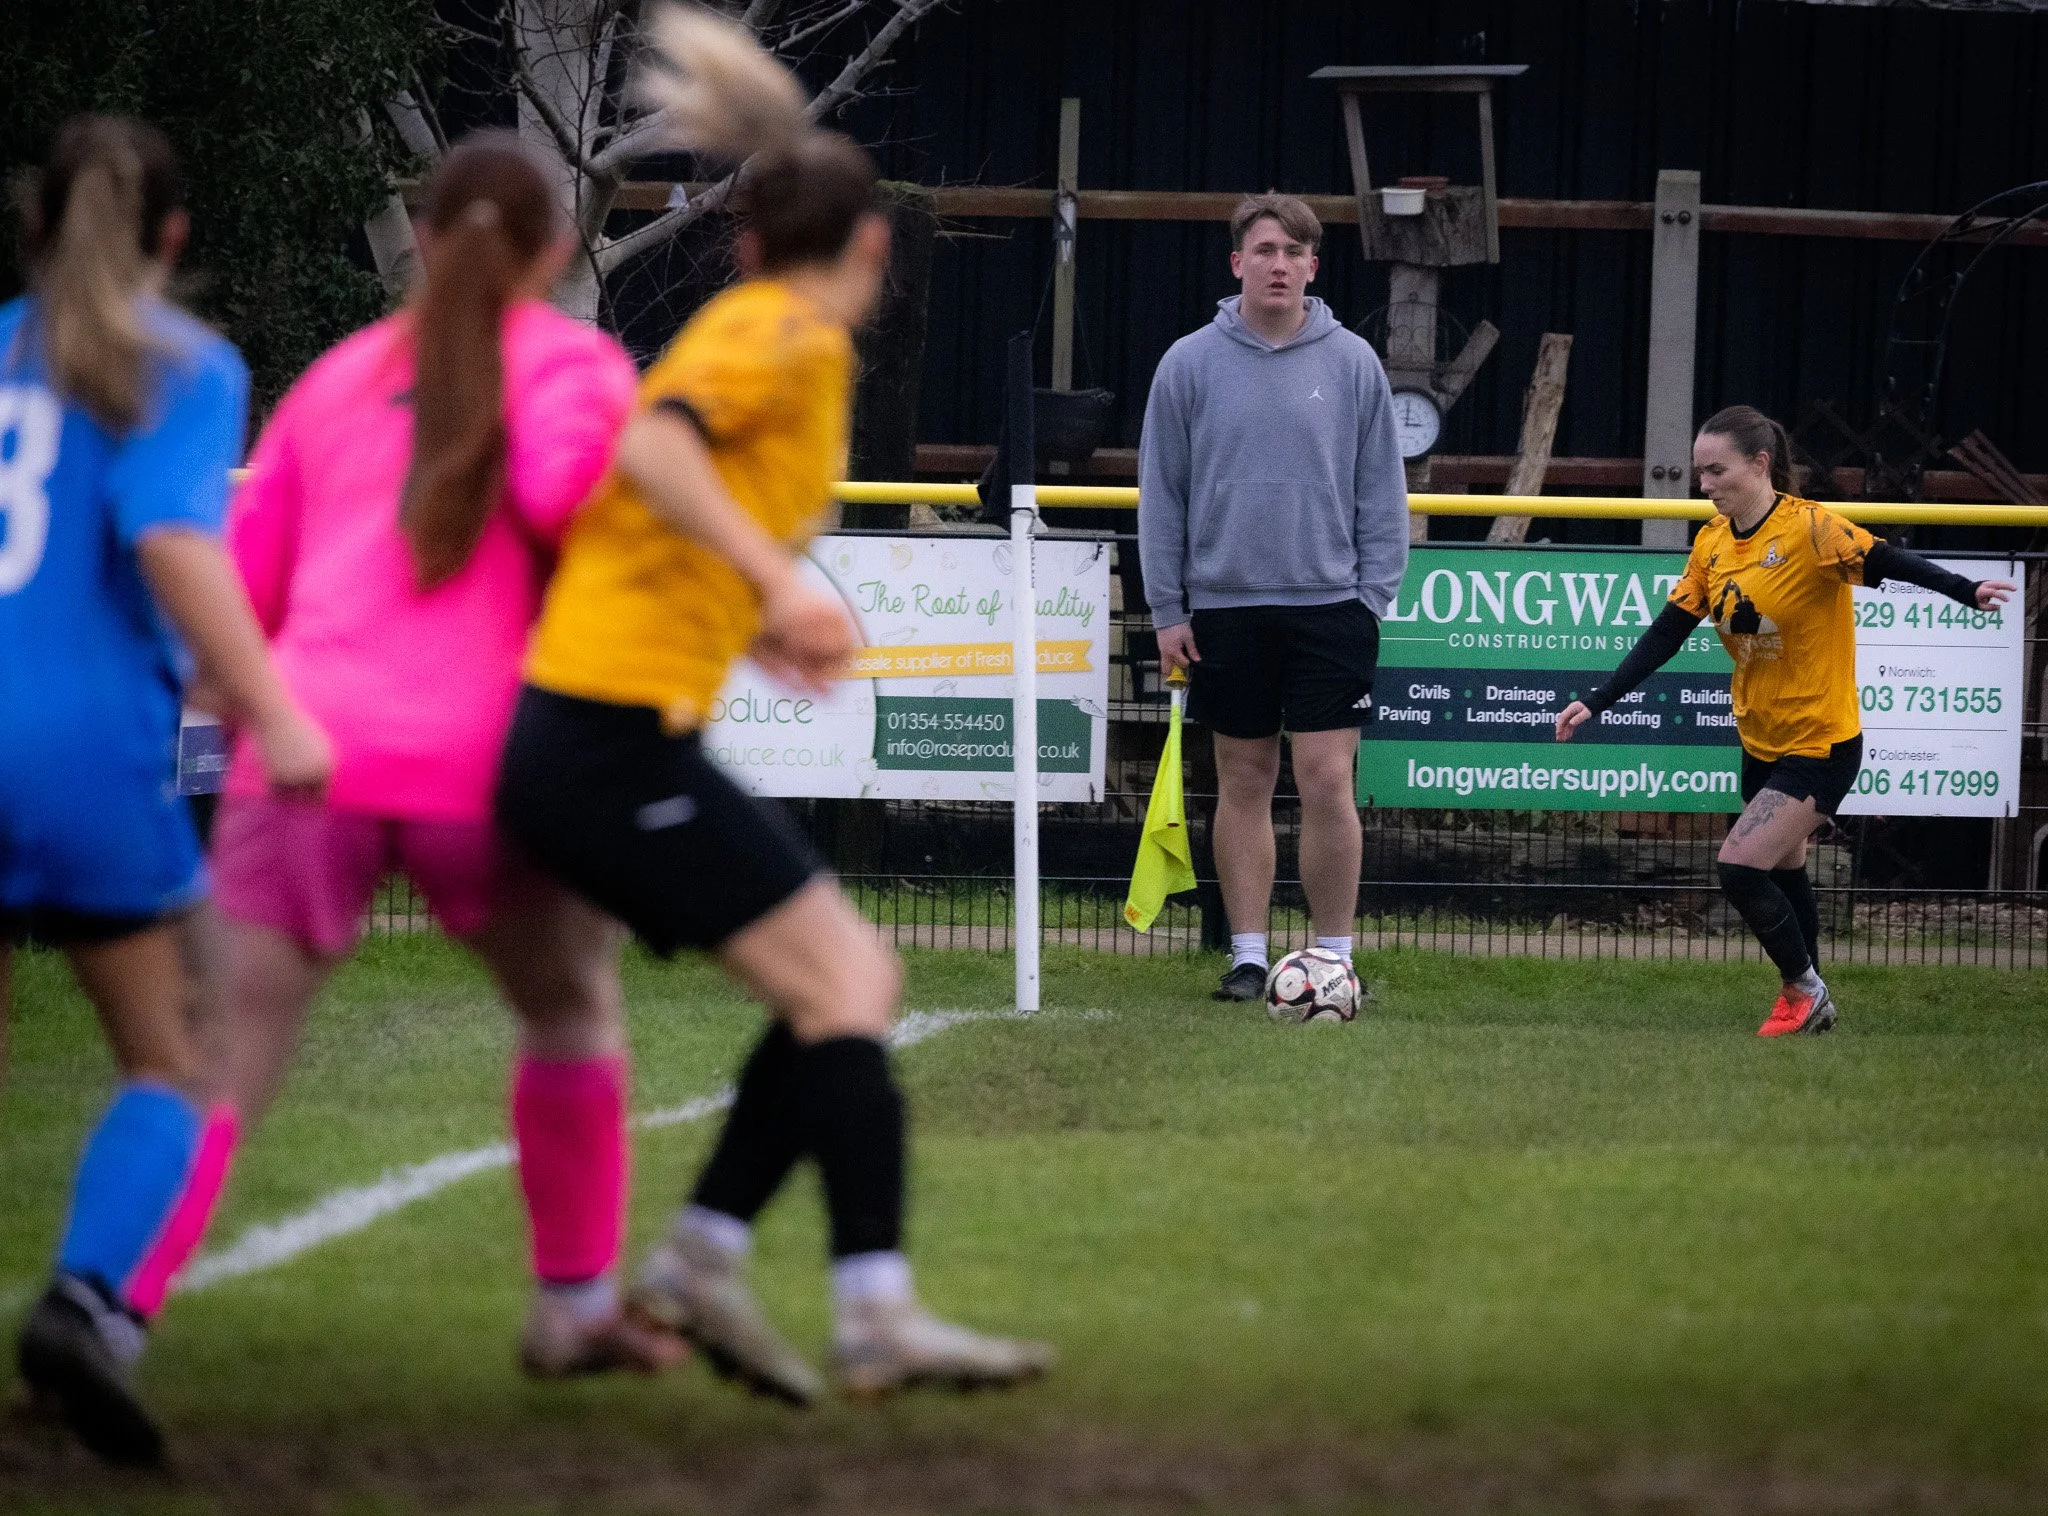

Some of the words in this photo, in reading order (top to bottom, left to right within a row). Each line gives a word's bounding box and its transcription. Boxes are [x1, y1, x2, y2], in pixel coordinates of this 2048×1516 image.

[857, 580, 905, 613] The
[911, 583, 970, 618] Root
[976, 589, 1003, 626] of
[1011, 586, 1095, 627] uality
[1904, 602, 2004, 630] 414484
[1449, 633, 1605, 650] CONSTRUCTION
[1613, 635, 1711, 653] SUIES
[896, 652, 952, 672] supplier
[956, 651, 973, 669] of
[975, 650, 1011, 668] Fresh
[1037, 648, 1075, 665] duce
[1888, 666, 1936, 678] Norwich:
[1408, 684, 1451, 700] Civils
[1486, 686, 1556, 704] Drainage
[1680, 689, 1733, 705] Buildin
[1903, 686, 2002, 714] 731555
[887, 712, 939, 731] 01354
[941, 713, 1006, 731] 554450
[1379, 706, 1431, 725] Paving
[1600, 710, 1662, 728] Roofing
[887, 738, 1080, 761] info@roseproduco.uk
[1878, 749, 1941, 761] Colchester:
[1407, 758, 1738, 799] longwatersupply.com
[1900, 769, 2000, 797] 417999
